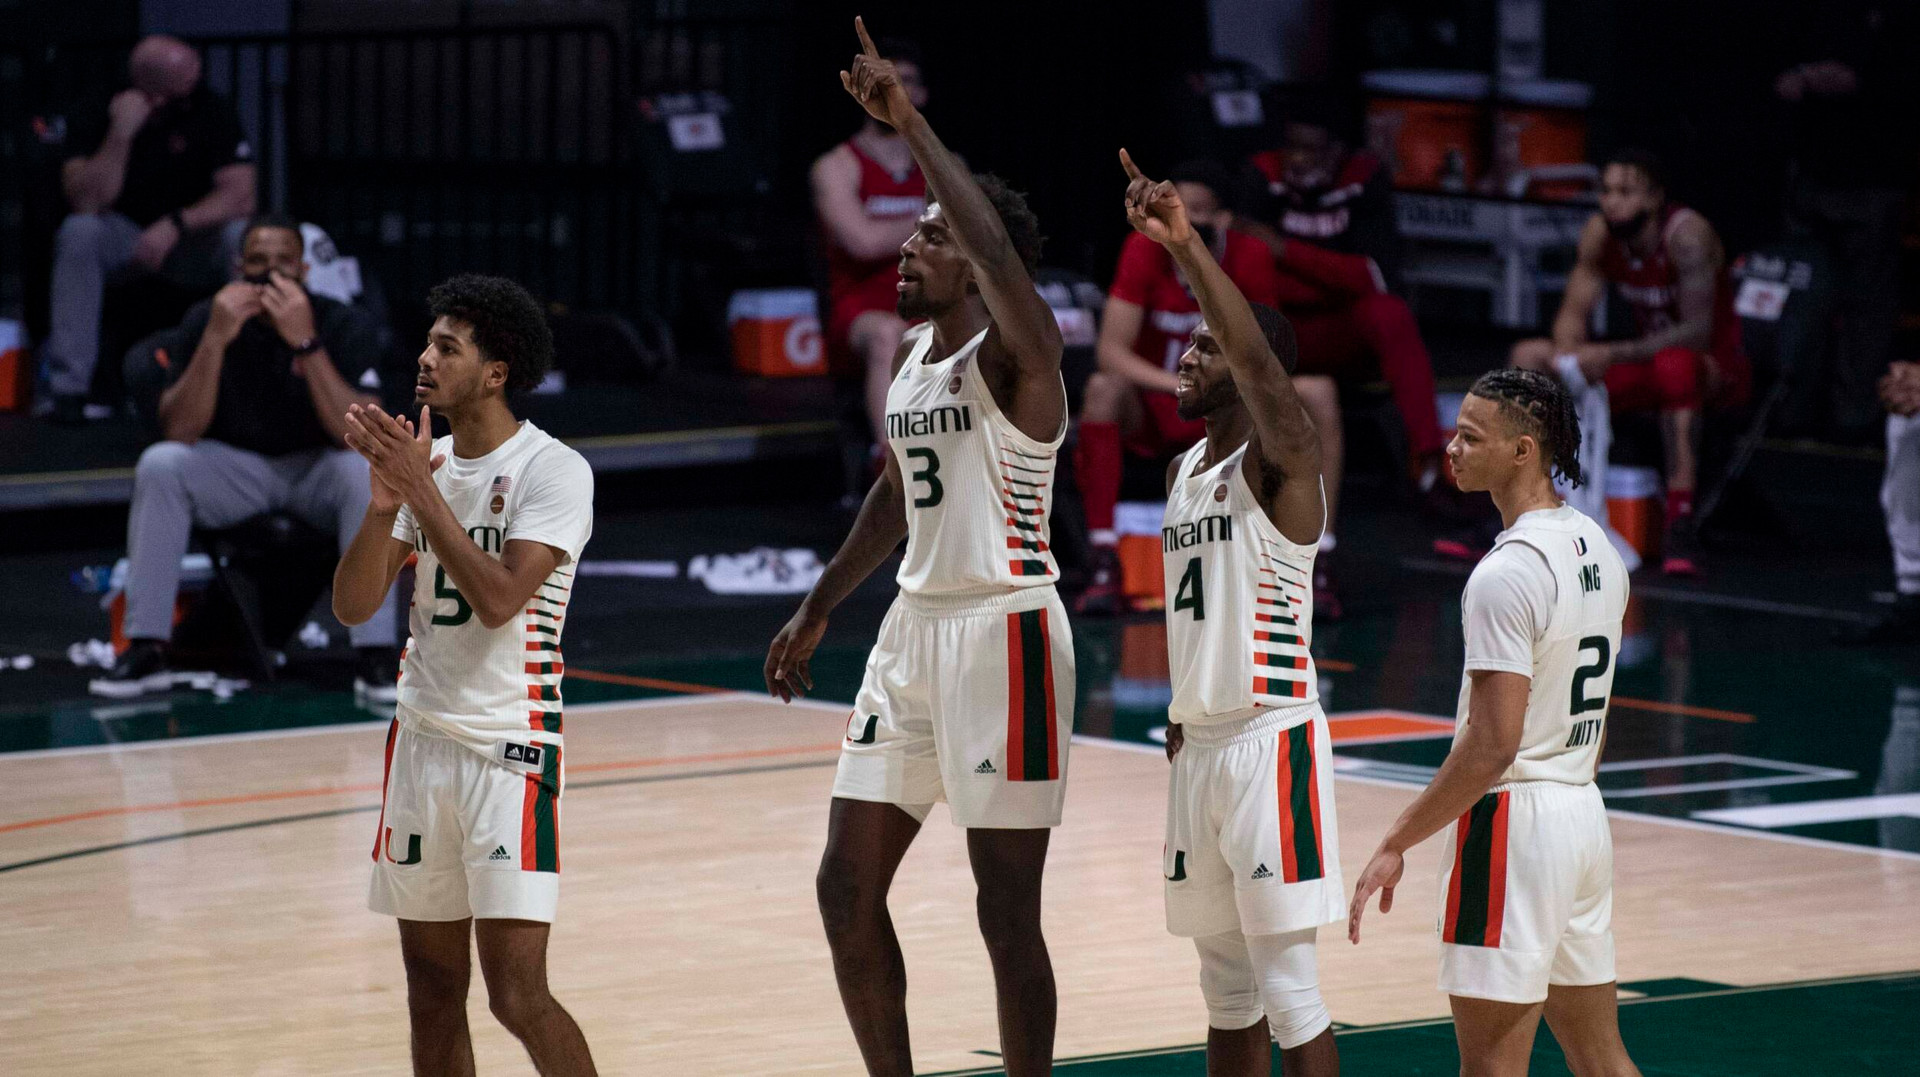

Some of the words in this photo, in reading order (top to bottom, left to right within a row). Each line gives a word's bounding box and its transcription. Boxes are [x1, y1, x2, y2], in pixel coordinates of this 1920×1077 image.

[905, 446, 945, 509] 3
[1572, 536, 1588, 557] U
[431, 563, 474, 627] 5
[1174, 556, 1206, 621] 4
[1569, 635, 1611, 716] 2
[1565, 718, 1602, 748] UNITY
[385, 826, 422, 866] U
[1251, 871, 1274, 880] adidas
